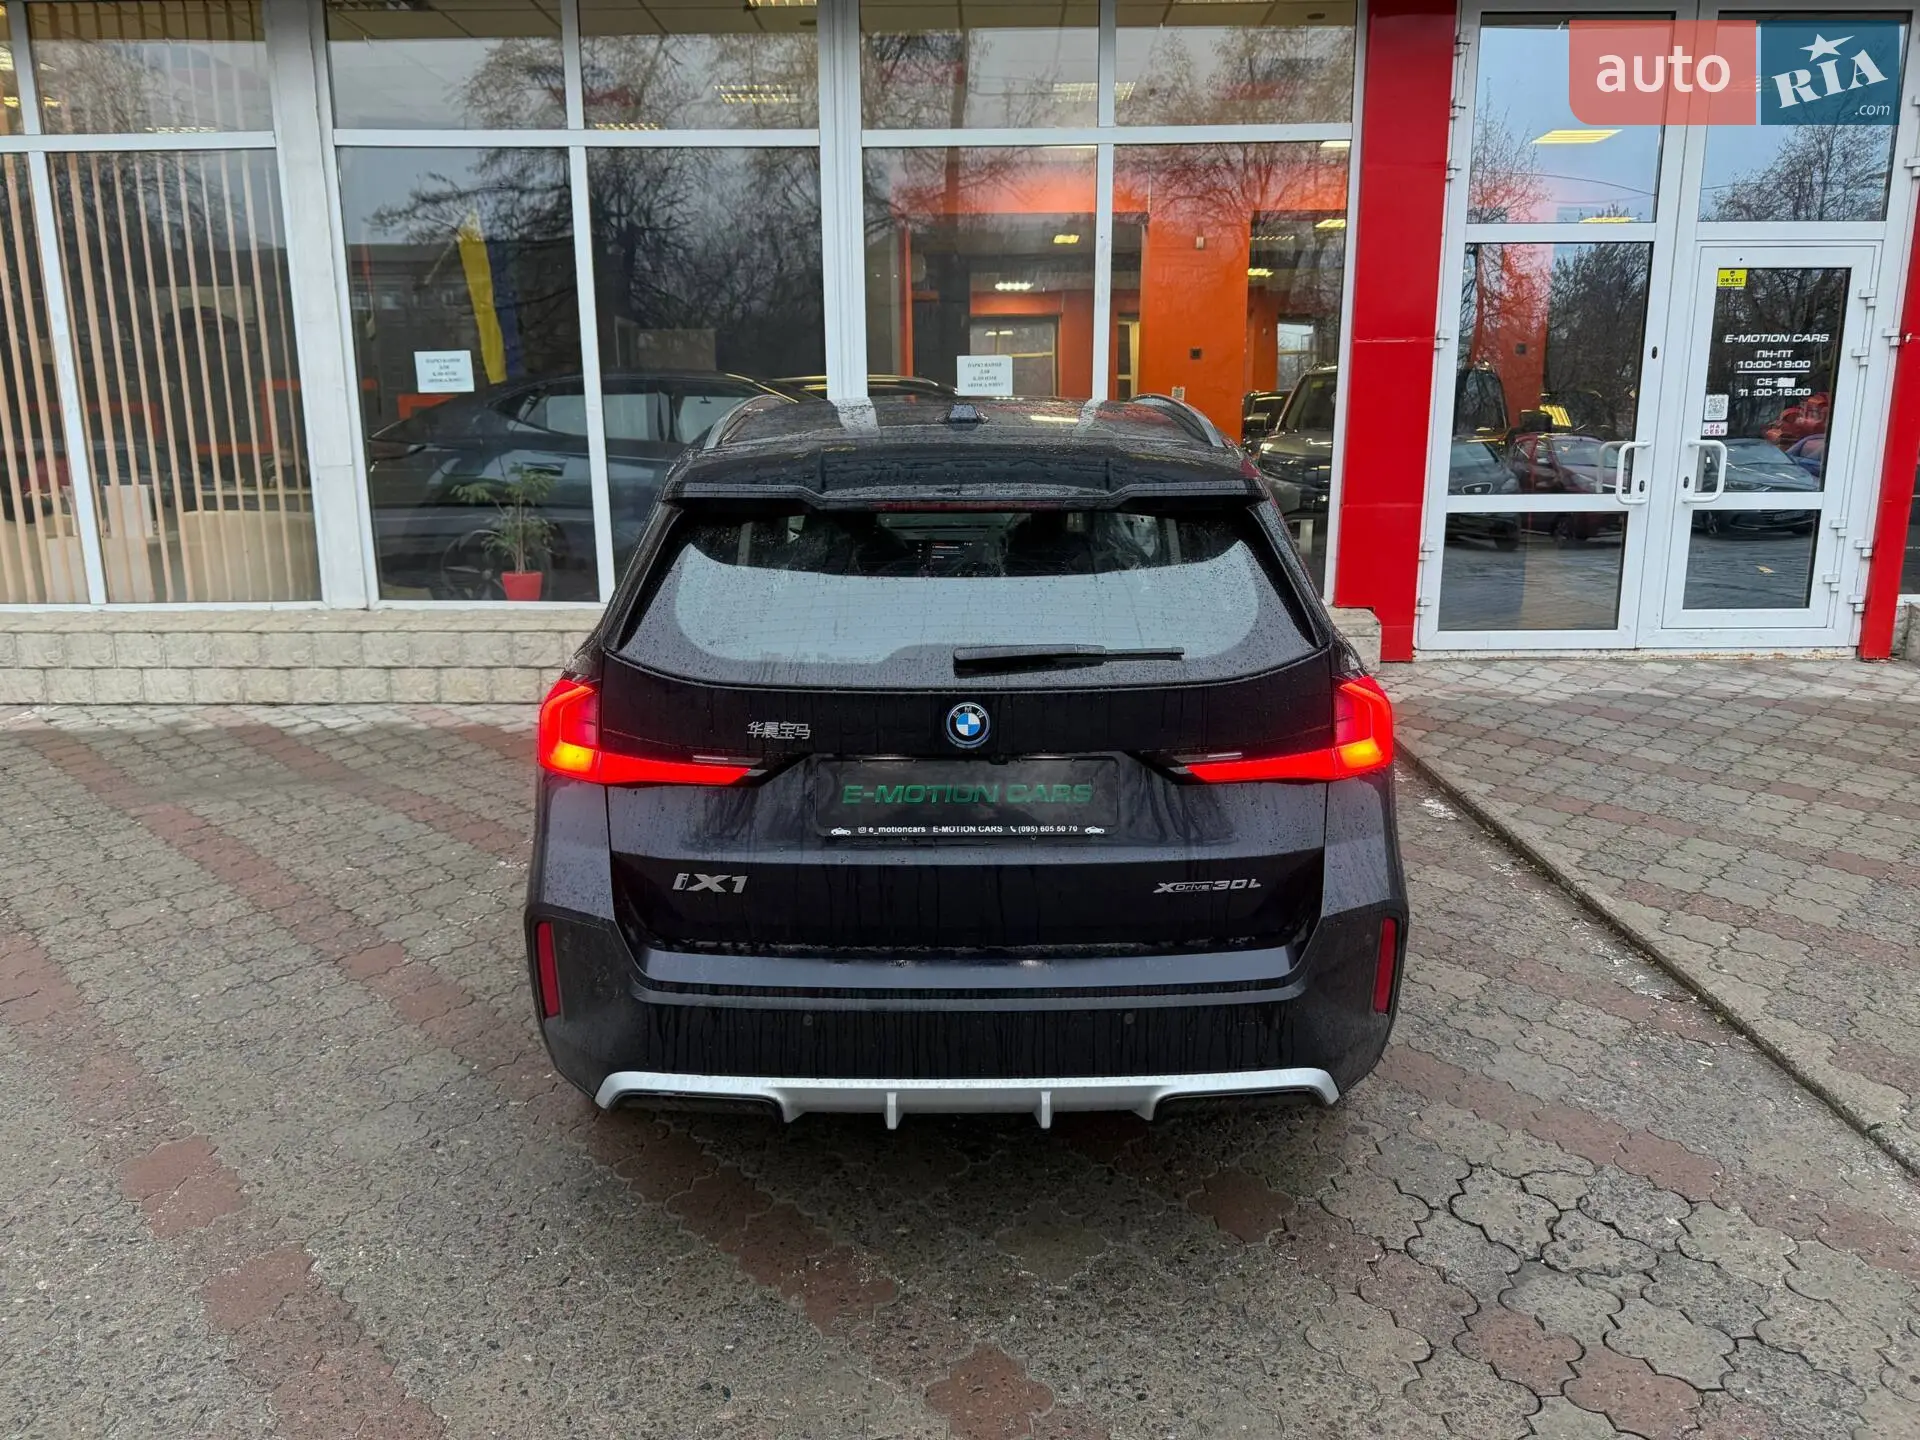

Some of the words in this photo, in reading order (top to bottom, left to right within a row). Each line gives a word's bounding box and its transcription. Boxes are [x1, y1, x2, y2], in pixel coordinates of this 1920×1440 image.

[1724, 334, 1790, 343] E-MOTION
[1792, 333, 1830, 343] CARS
[1756, 349, 1794, 358] ПН-ПТ
[1737, 360, 1811, 369] 10:00-19:00
[747, 721, 811, 740] 华晨宝马
[842, 784, 998, 804] E-MOTION
[1006, 784, 1093, 804] CARS
[932, 825, 977, 833] E-MOTION
[978, 825, 1003, 833] CARS
[672, 872, 749, 894] iX1
